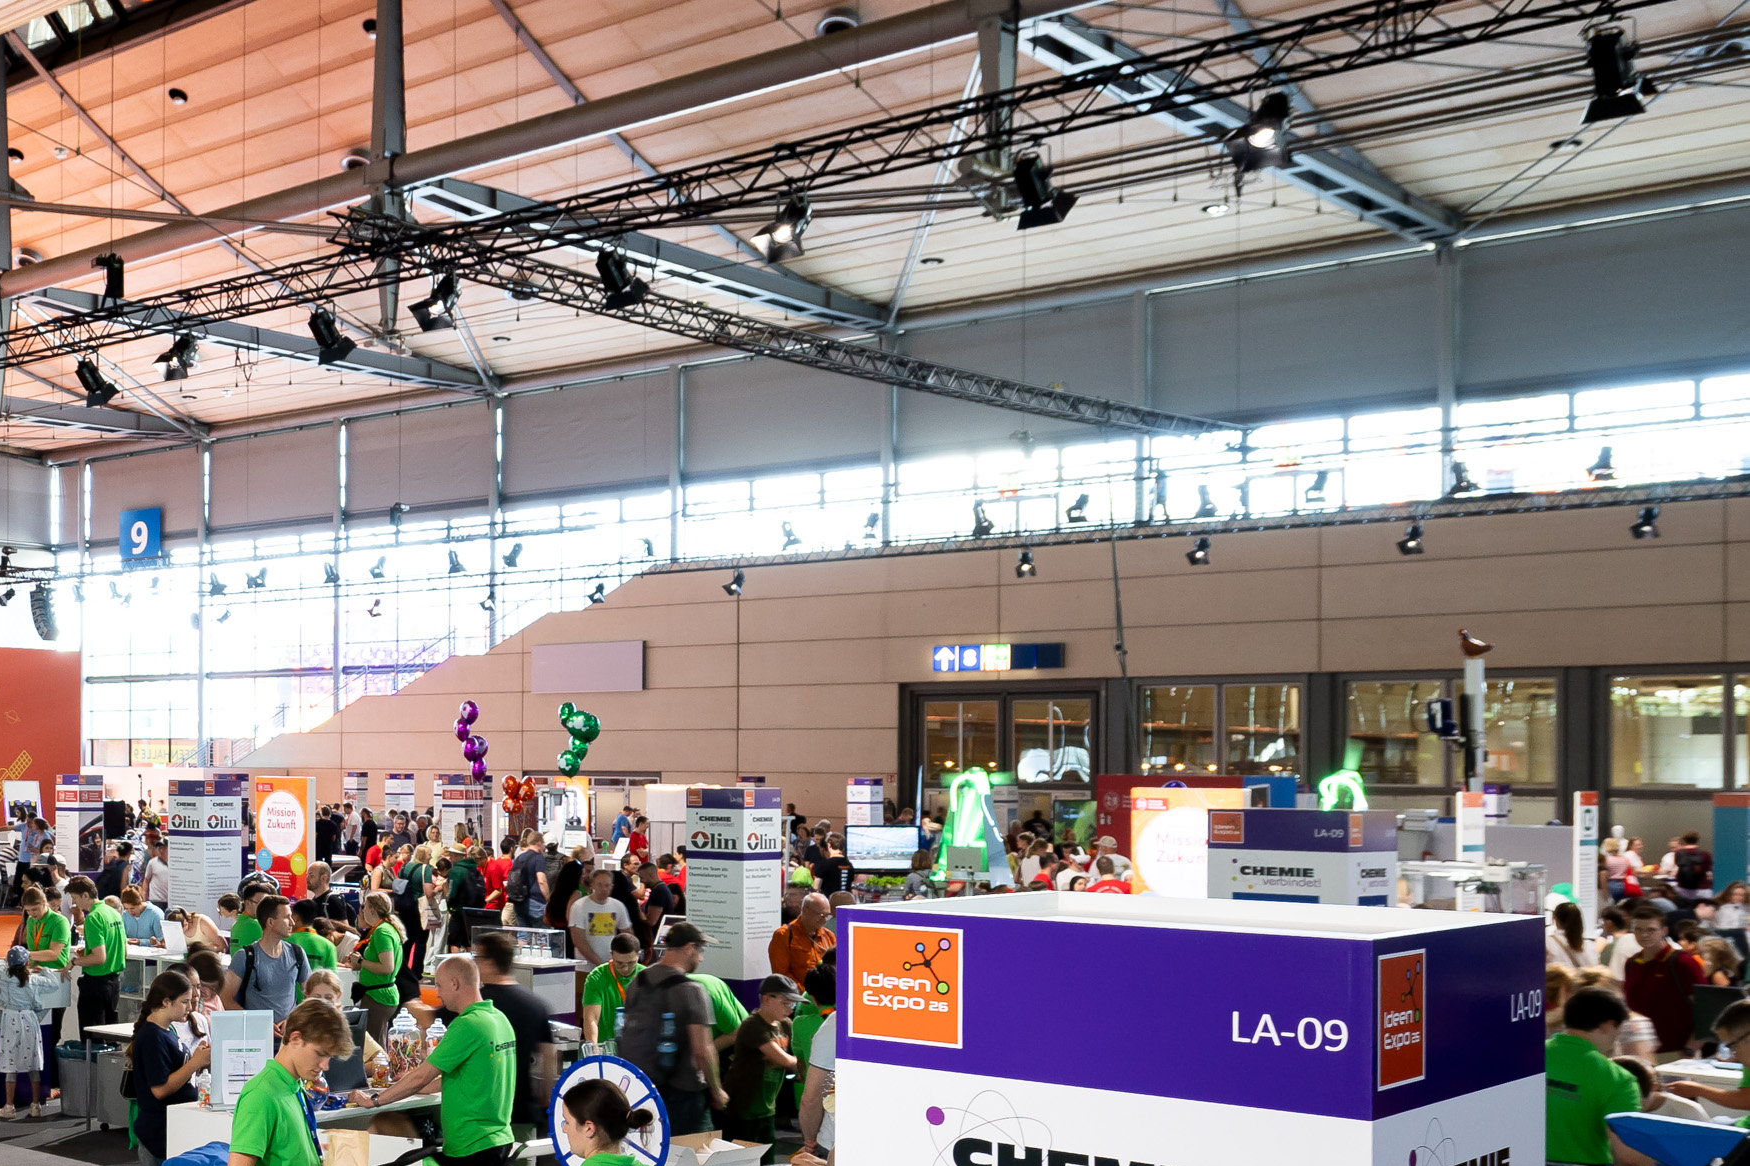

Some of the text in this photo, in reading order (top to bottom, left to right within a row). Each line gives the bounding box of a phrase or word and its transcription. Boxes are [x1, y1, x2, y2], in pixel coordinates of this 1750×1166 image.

[131, 521, 148, 555] 9
[267, 807, 296, 817] Mission
[267, 818, 296, 829] Zukunft
[691, 831, 737, 850] Olin
[747, 832, 777, 850] Olin
[1156, 831, 1208, 848] Missio
[1156, 849, 1206, 864] Zukun
[1240, 865, 1314, 878] CHEMIE
[862, 971, 932, 993] Ideen
[862, 990, 949, 1013] Expo 26
[1511, 989, 1542, 1023] LA-09
[1384, 1005, 1413, 1029] Ideen
[1232, 1011, 1349, 1053] LA-09
[1384, 1028, 1410, 1052] Expo
